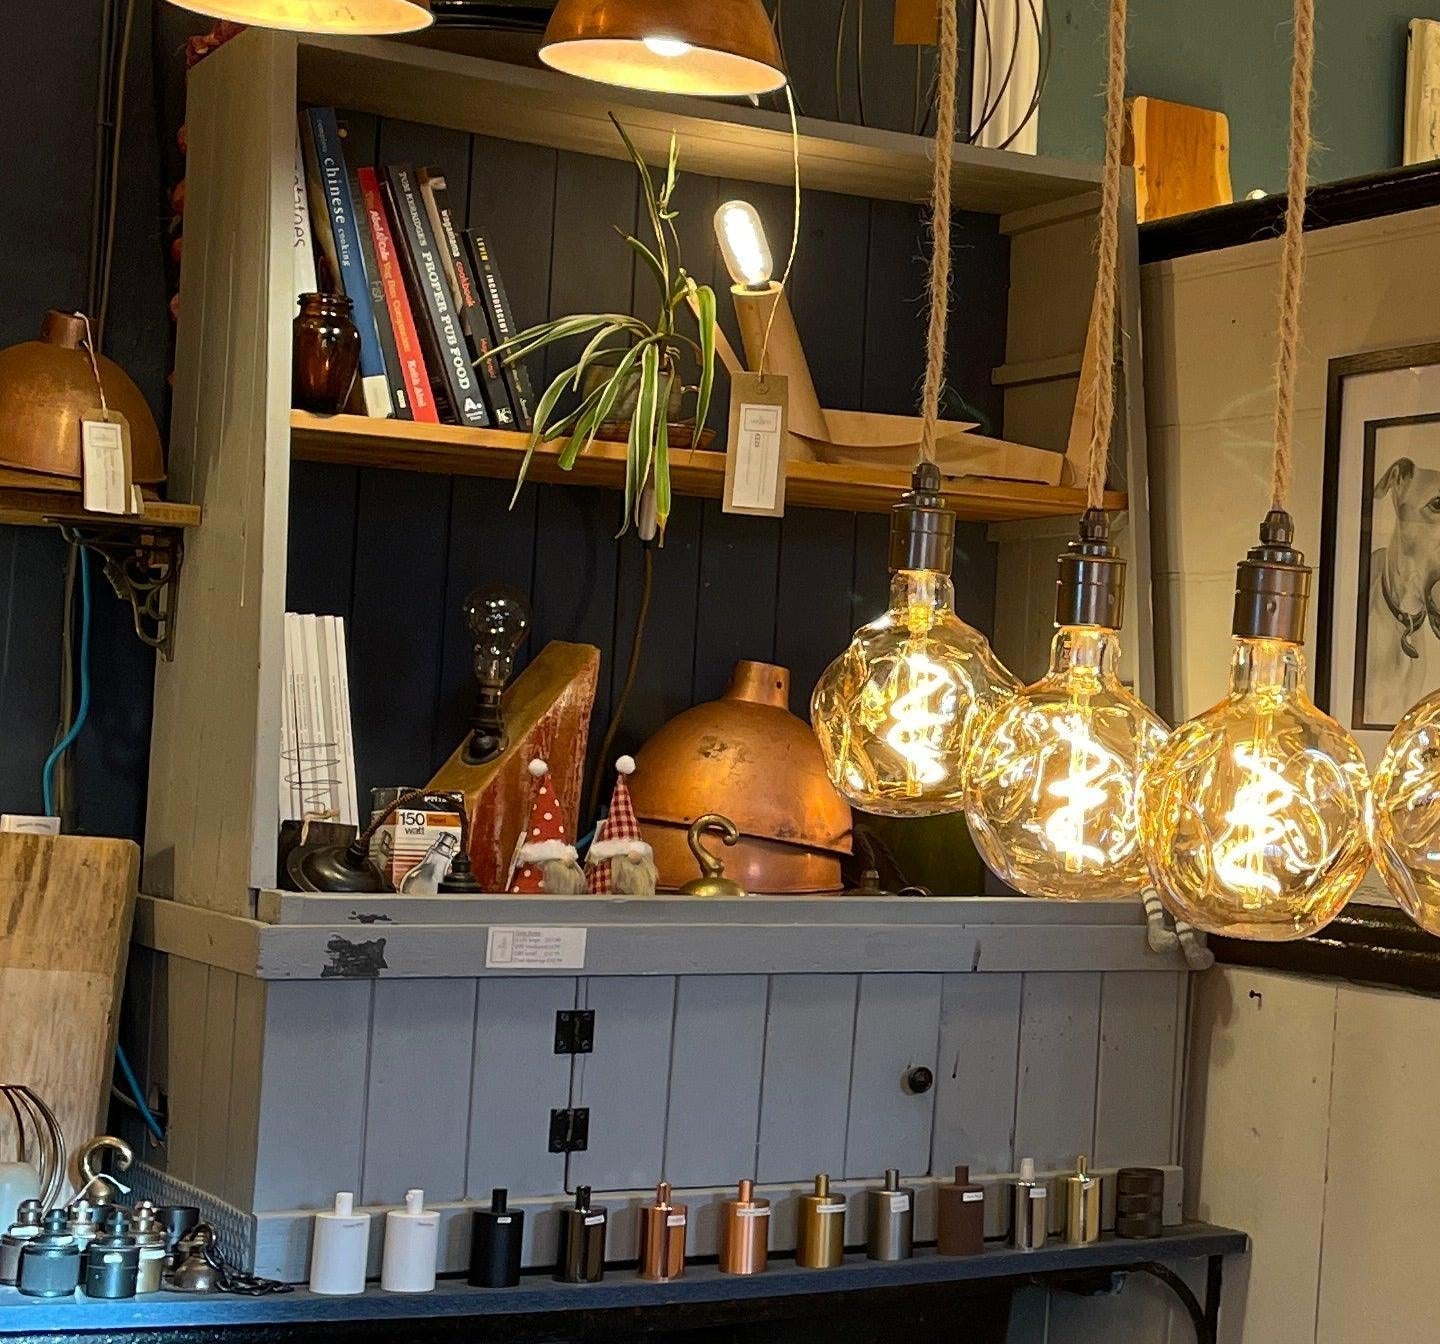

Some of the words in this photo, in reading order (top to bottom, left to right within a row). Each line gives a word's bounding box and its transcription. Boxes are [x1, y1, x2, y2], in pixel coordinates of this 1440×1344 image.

[323, 157, 346, 224] chinese
[337, 228, 351, 267] cooking
[422, 251, 449, 313] PROPER
[440, 314, 459, 346] PUB
[450, 346, 471, 390] FOOD
[400, 813, 425, 825] 150
[405, 826, 425, 835] watt
